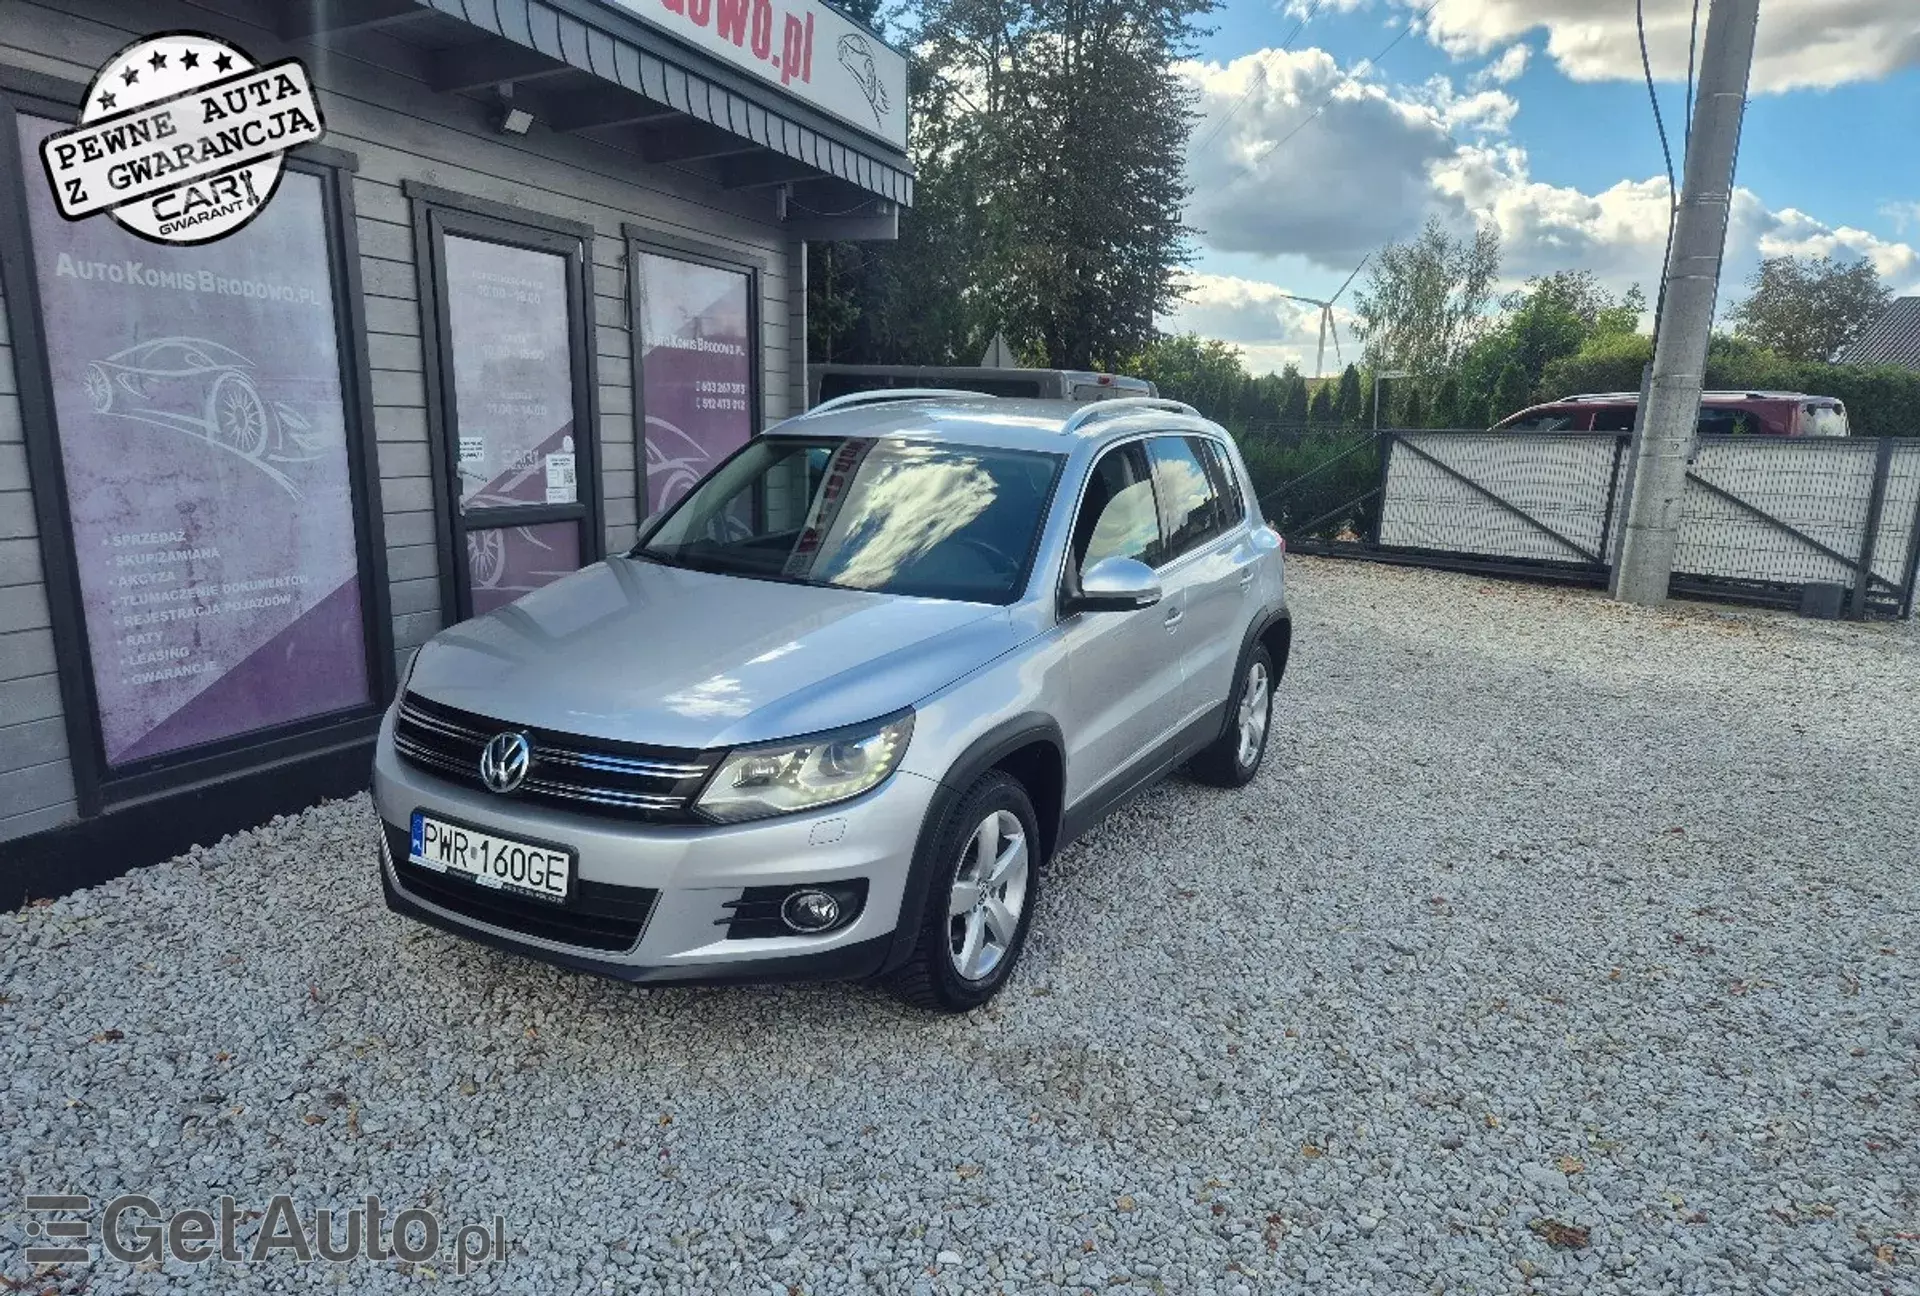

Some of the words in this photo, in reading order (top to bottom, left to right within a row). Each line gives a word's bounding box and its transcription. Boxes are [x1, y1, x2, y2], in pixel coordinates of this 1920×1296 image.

[661, 0, 814, 85] wo.pl
[112, 528, 186, 547] SPRZEDAŻ
[123, 604, 221, 627] REJESTRACJA
[126, 631, 164, 646] RATY
[129, 647, 190, 665] LEASING
[132, 661, 219, 685] GWARANCJE
[424, 822, 468, 868] PWR
[480, 840, 565, 893] 160GE
